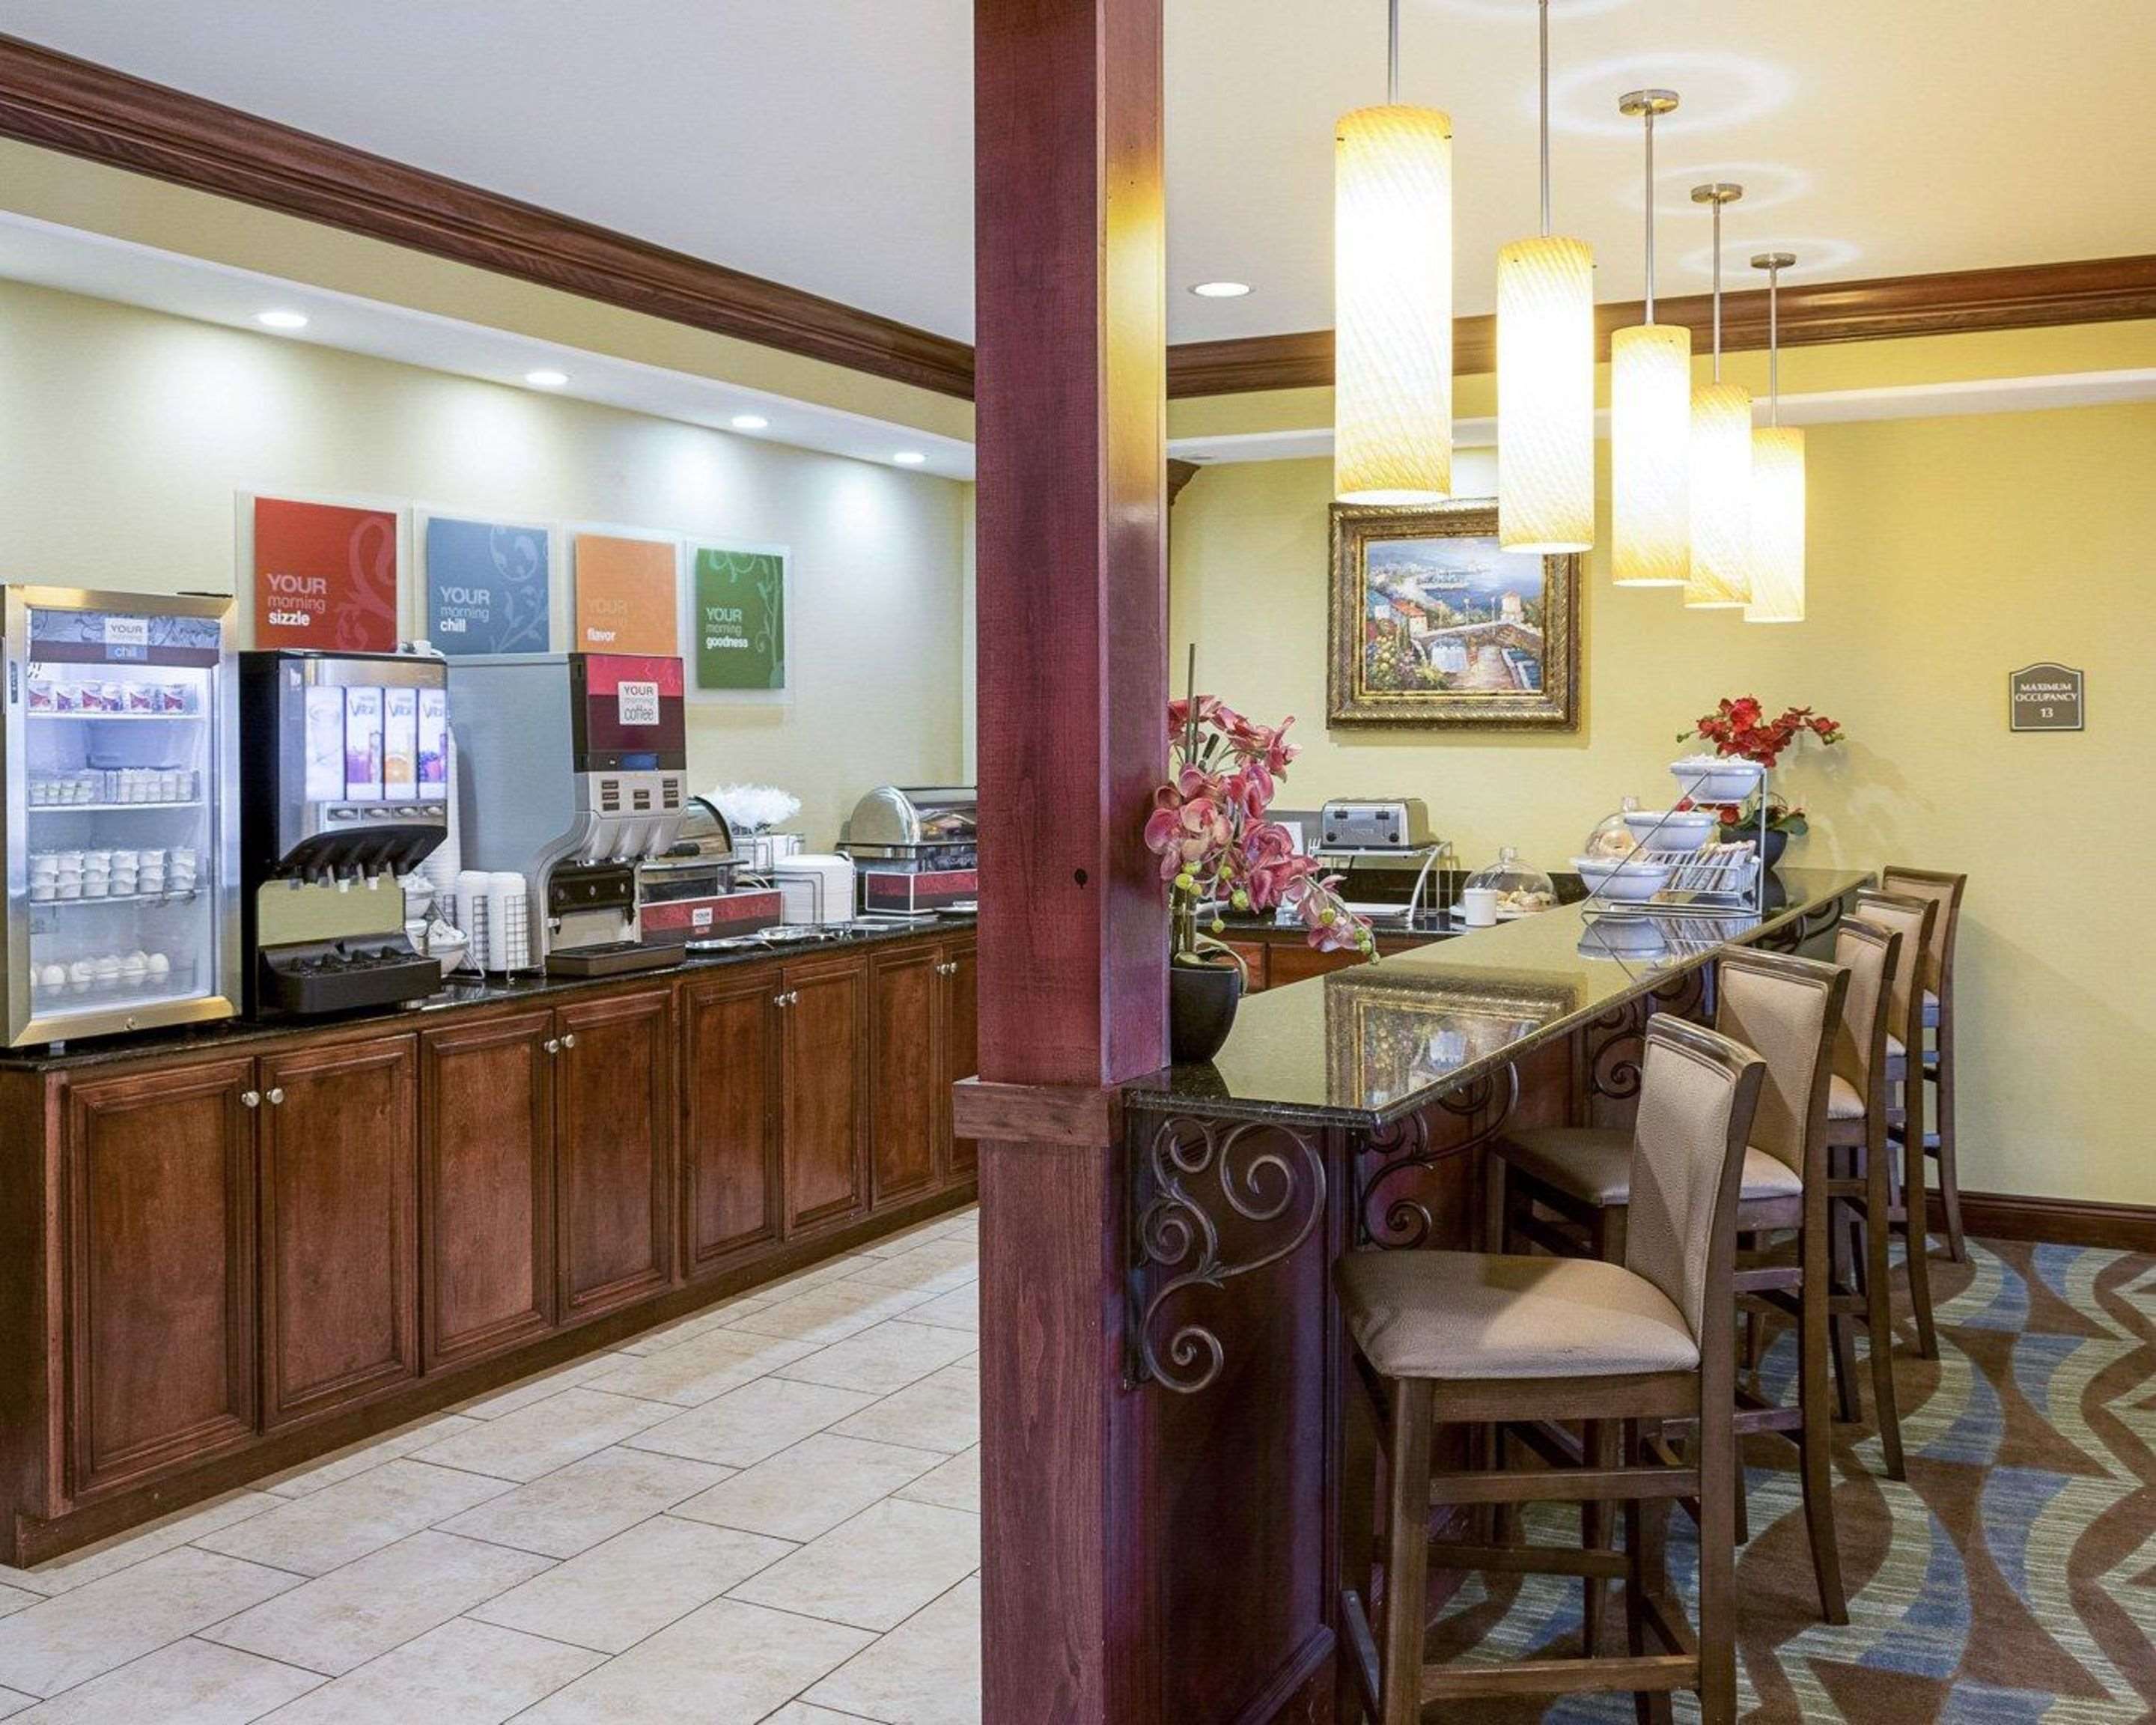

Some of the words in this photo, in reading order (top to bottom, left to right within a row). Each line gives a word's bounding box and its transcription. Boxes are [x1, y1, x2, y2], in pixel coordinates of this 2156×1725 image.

[267, 573, 326, 594] YOUR
[439, 585, 490, 605] YOUR
[268, 594, 326, 614] morning
[269, 609, 310, 627] sizzle
[440, 606, 490, 623] morning
[706, 606, 742, 622] YOUR
[111, 624, 143, 633] YOUR
[440, 618, 466, 633] chill
[706, 623, 742, 637] morning
[587, 627, 616, 642] flavor
[706, 636, 748, 649] goodness
[114, 646, 138, 657] chill
[624, 686, 654, 696] YOUR
[2021, 683, 2072, 691] MAXIMUM
[2015, 693, 2077, 702] OCCUPANCY
[624, 705, 654, 721] coffee
[2040, 708, 2053, 718] 13
